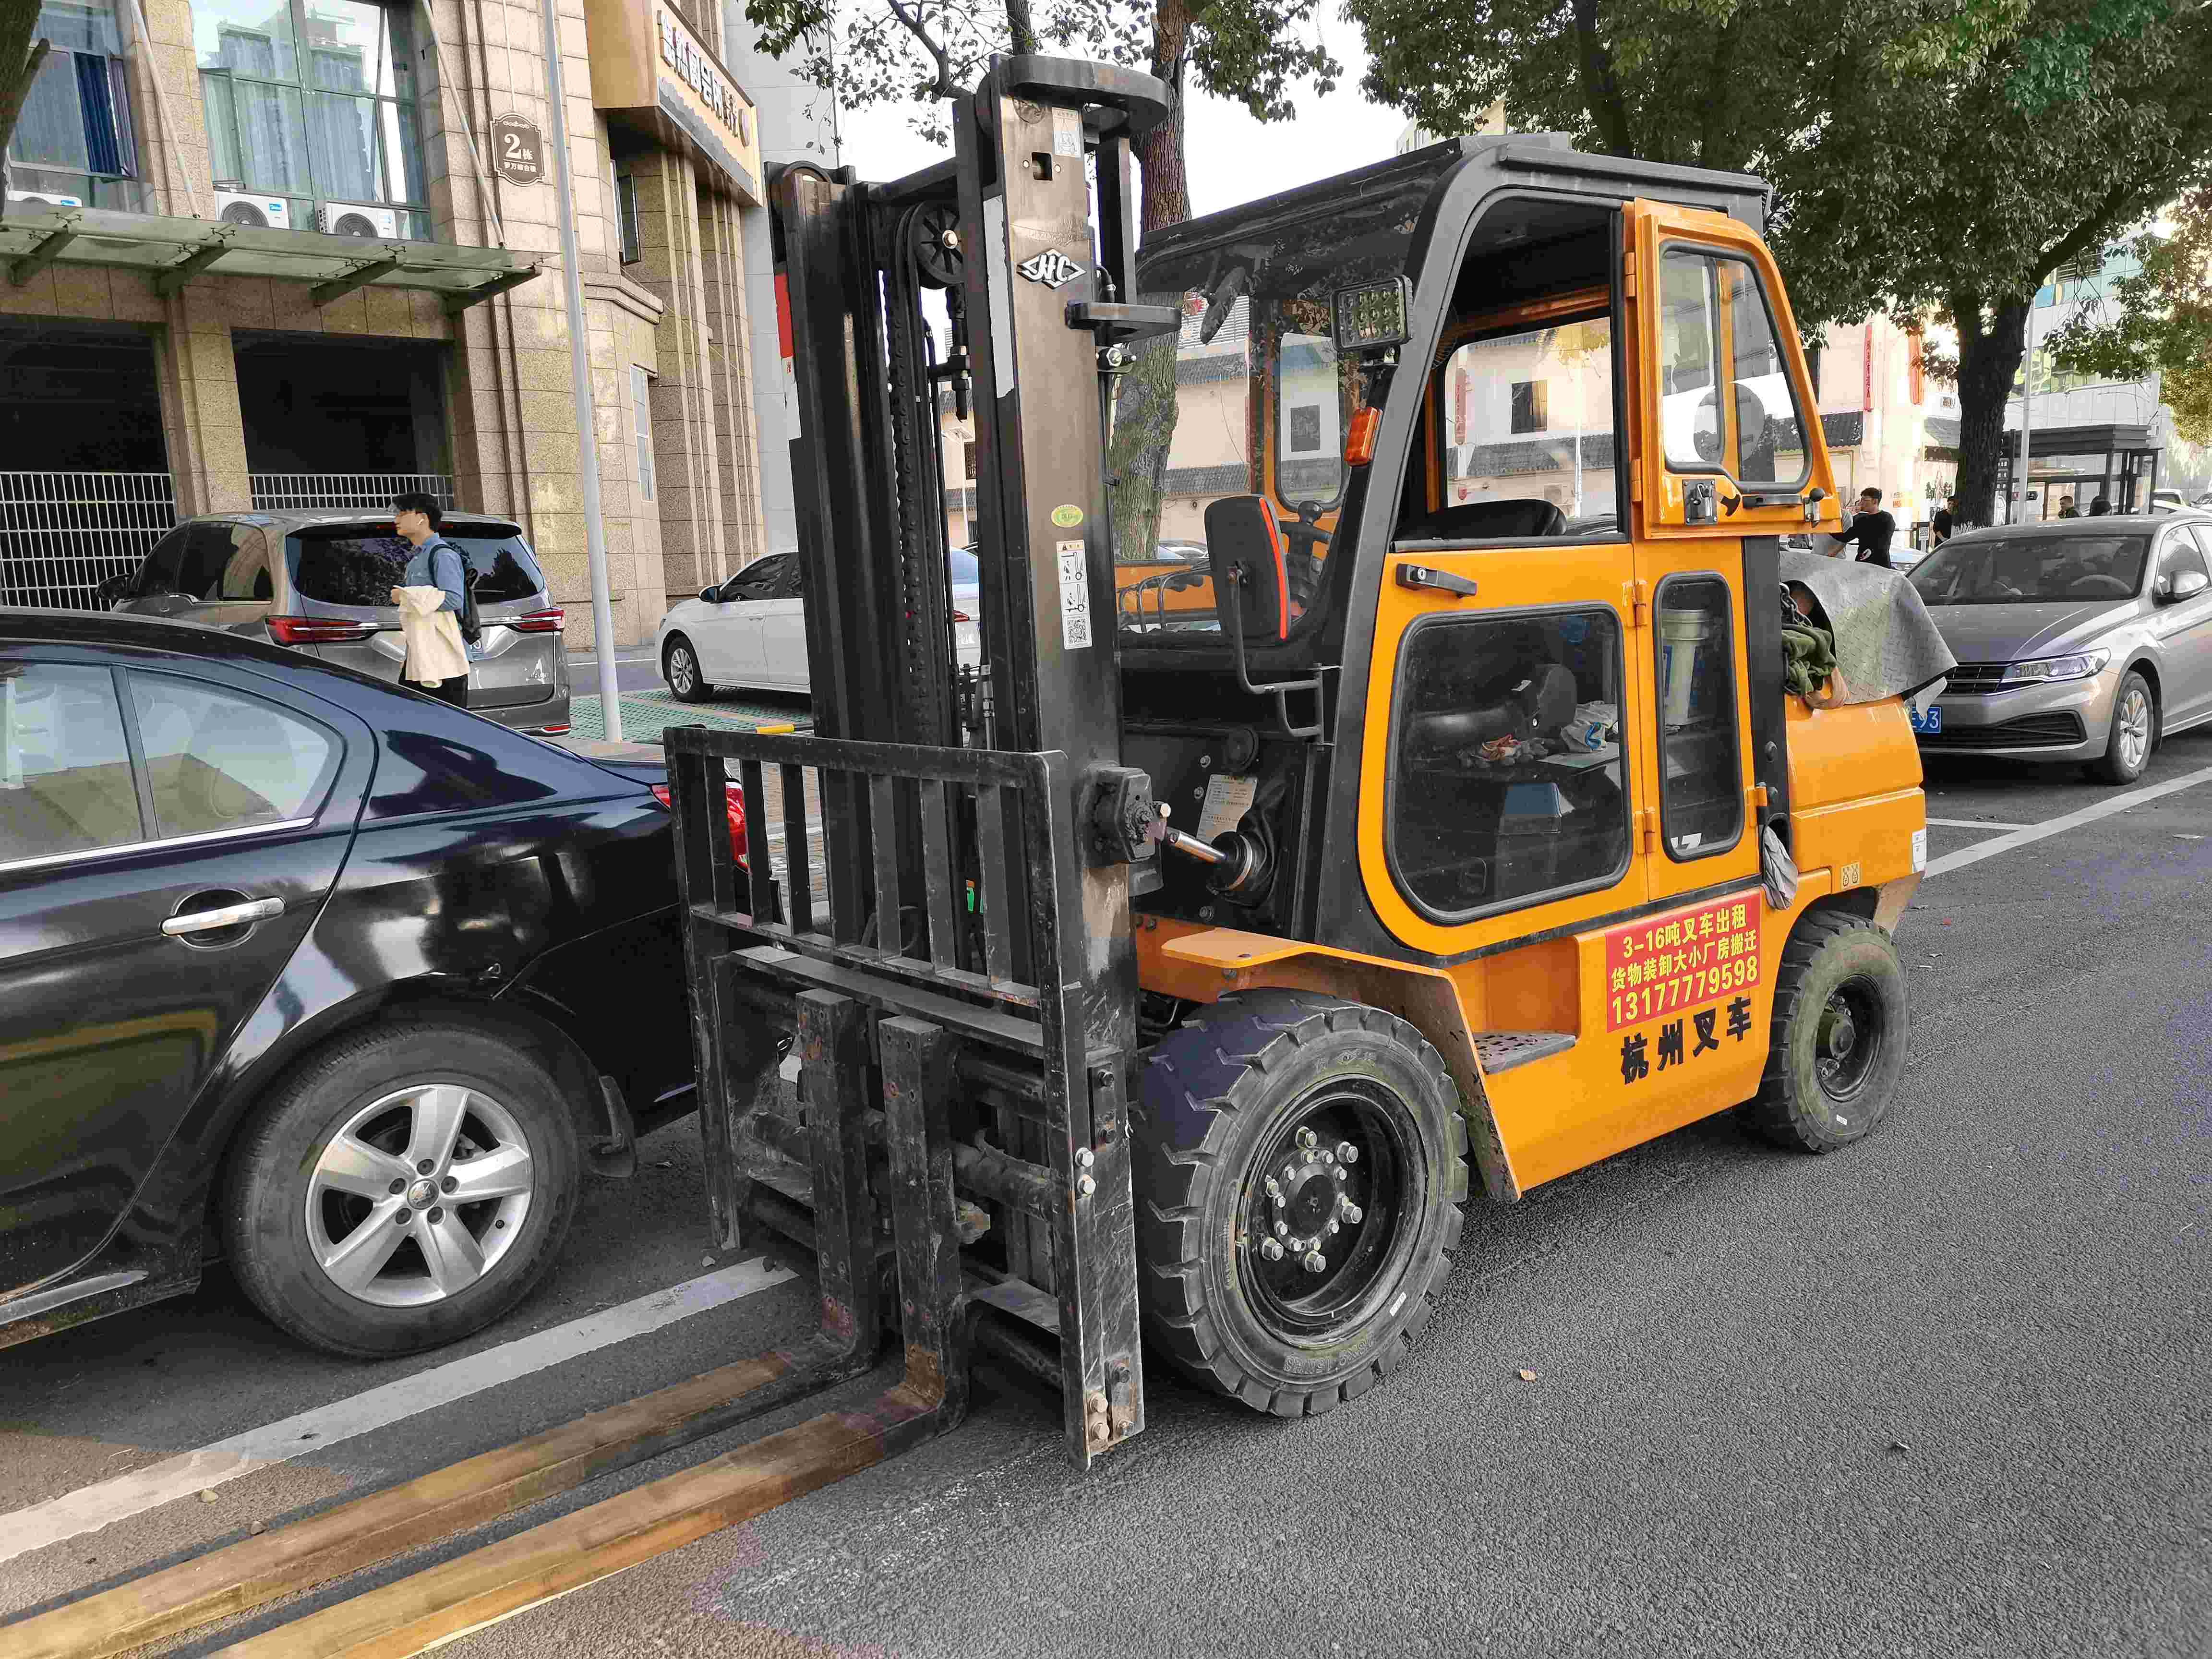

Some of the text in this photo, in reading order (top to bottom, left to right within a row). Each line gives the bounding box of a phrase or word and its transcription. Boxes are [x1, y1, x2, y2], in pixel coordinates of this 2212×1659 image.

[1611, 929, 1757, 993] 货物装卸大小厂房搬迁
[1623, 903, 1746, 959] 3-16吨叉车出租
[1612, 955, 1758, 1025] 13177779598
[1620, 996, 1752, 1085] 杭州叉车
